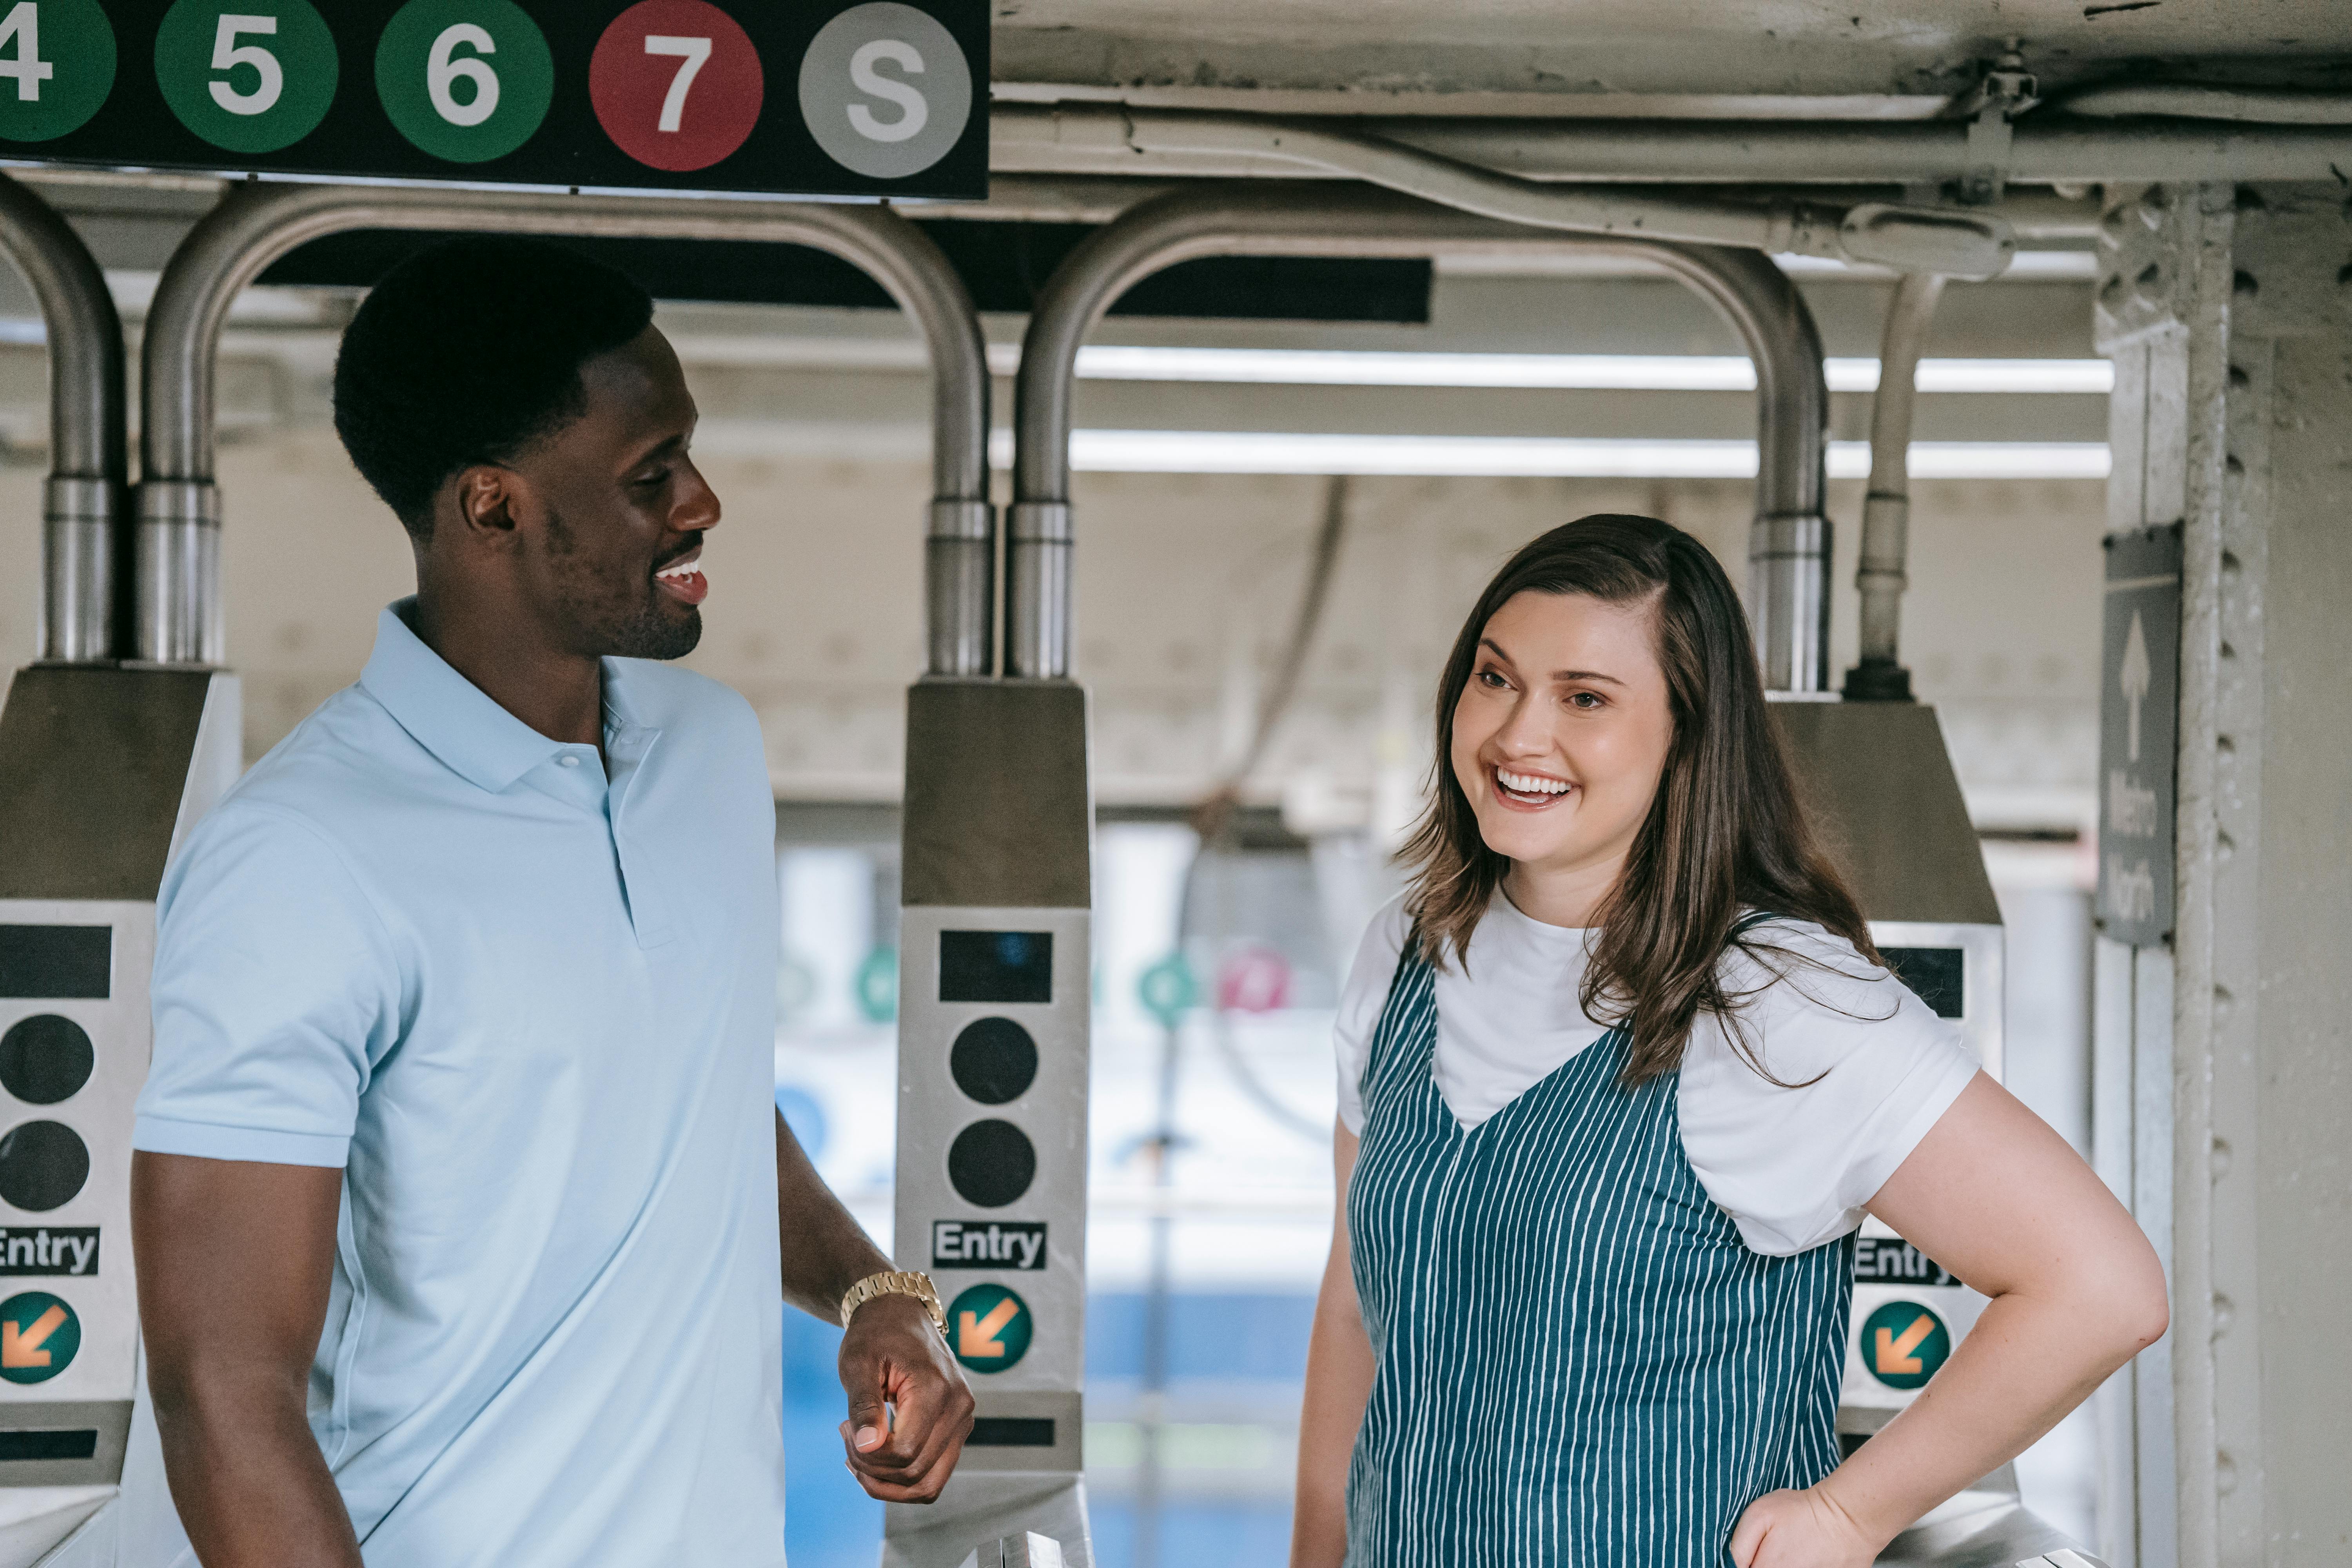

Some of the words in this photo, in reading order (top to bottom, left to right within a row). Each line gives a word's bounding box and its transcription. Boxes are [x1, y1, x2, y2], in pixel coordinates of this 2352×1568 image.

[0, 2, 53, 102] 4
[209, 14, 283, 115] 5
[427, 23, 499, 126] 6
[645, 35, 712, 132] 7
[847, 40, 928, 143] S
[0, 1229, 96, 1274] ntry
[935, 1223, 1043, 1268] Entry
